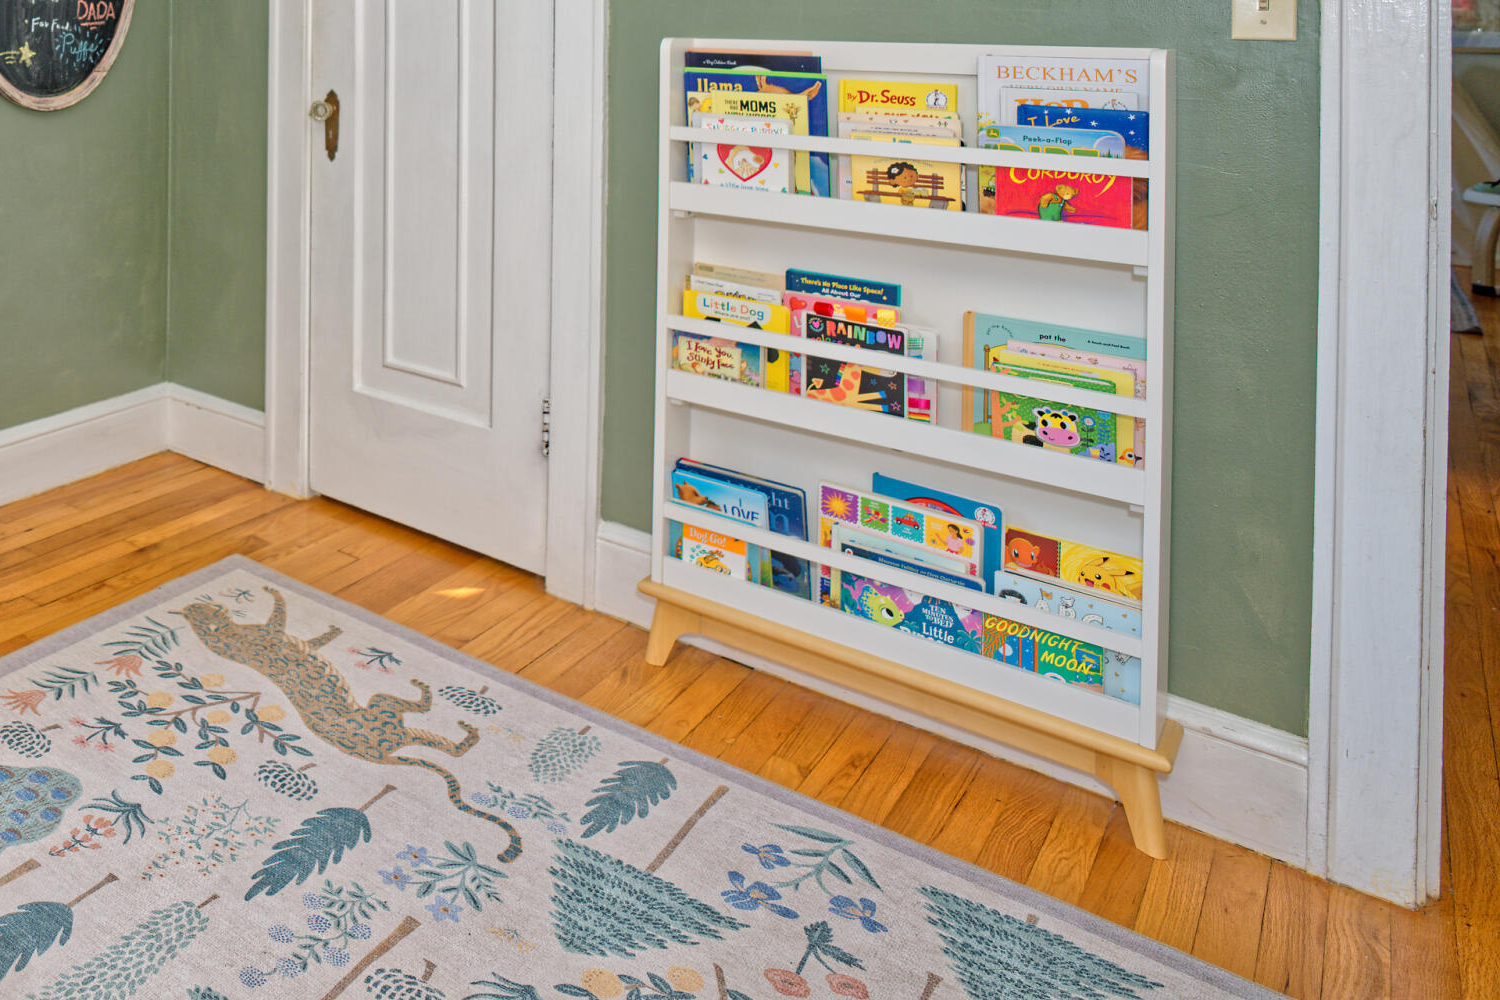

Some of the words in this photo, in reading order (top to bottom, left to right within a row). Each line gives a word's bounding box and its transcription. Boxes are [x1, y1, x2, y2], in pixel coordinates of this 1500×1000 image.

[76, 0, 116, 21] DADA
[31, 16, 49, 33] Fav
[996, 65, 1138, 84] BECKHAM'S
[697, 78, 743, 93] llama
[740, 99, 777, 114] MOMS
[847, 92, 857, 102] By
[857, 90, 879, 104] Dr.
[880, 89, 917, 107] Seuss
[1044, 114, 1081, 128] Love
[800, 276, 822, 287] There's
[831, 281, 849, 290] Place
[849, 284, 862, 292] Like
[862, 286, 885, 295] Space!
[830, 288, 849, 297] About
[703, 297, 737, 313] Little
[740, 304, 764, 321] Dog
[826, 320, 902, 350] RAINBOW
[1053, 334, 1067, 343] the
[686, 340, 692, 351] I
[694, 341, 713, 355] Love
[686, 351, 715, 370] Stinky
[709, 532, 727, 548] Go!
[922, 608, 955, 622] MINUTES
[928, 603, 947, 615] TEN
[932, 616, 955, 629] BED
[921, 621, 955, 644] Little
[984, 617, 1084, 654] GOODNIGHT
[1040, 650, 1094, 676] MOON
